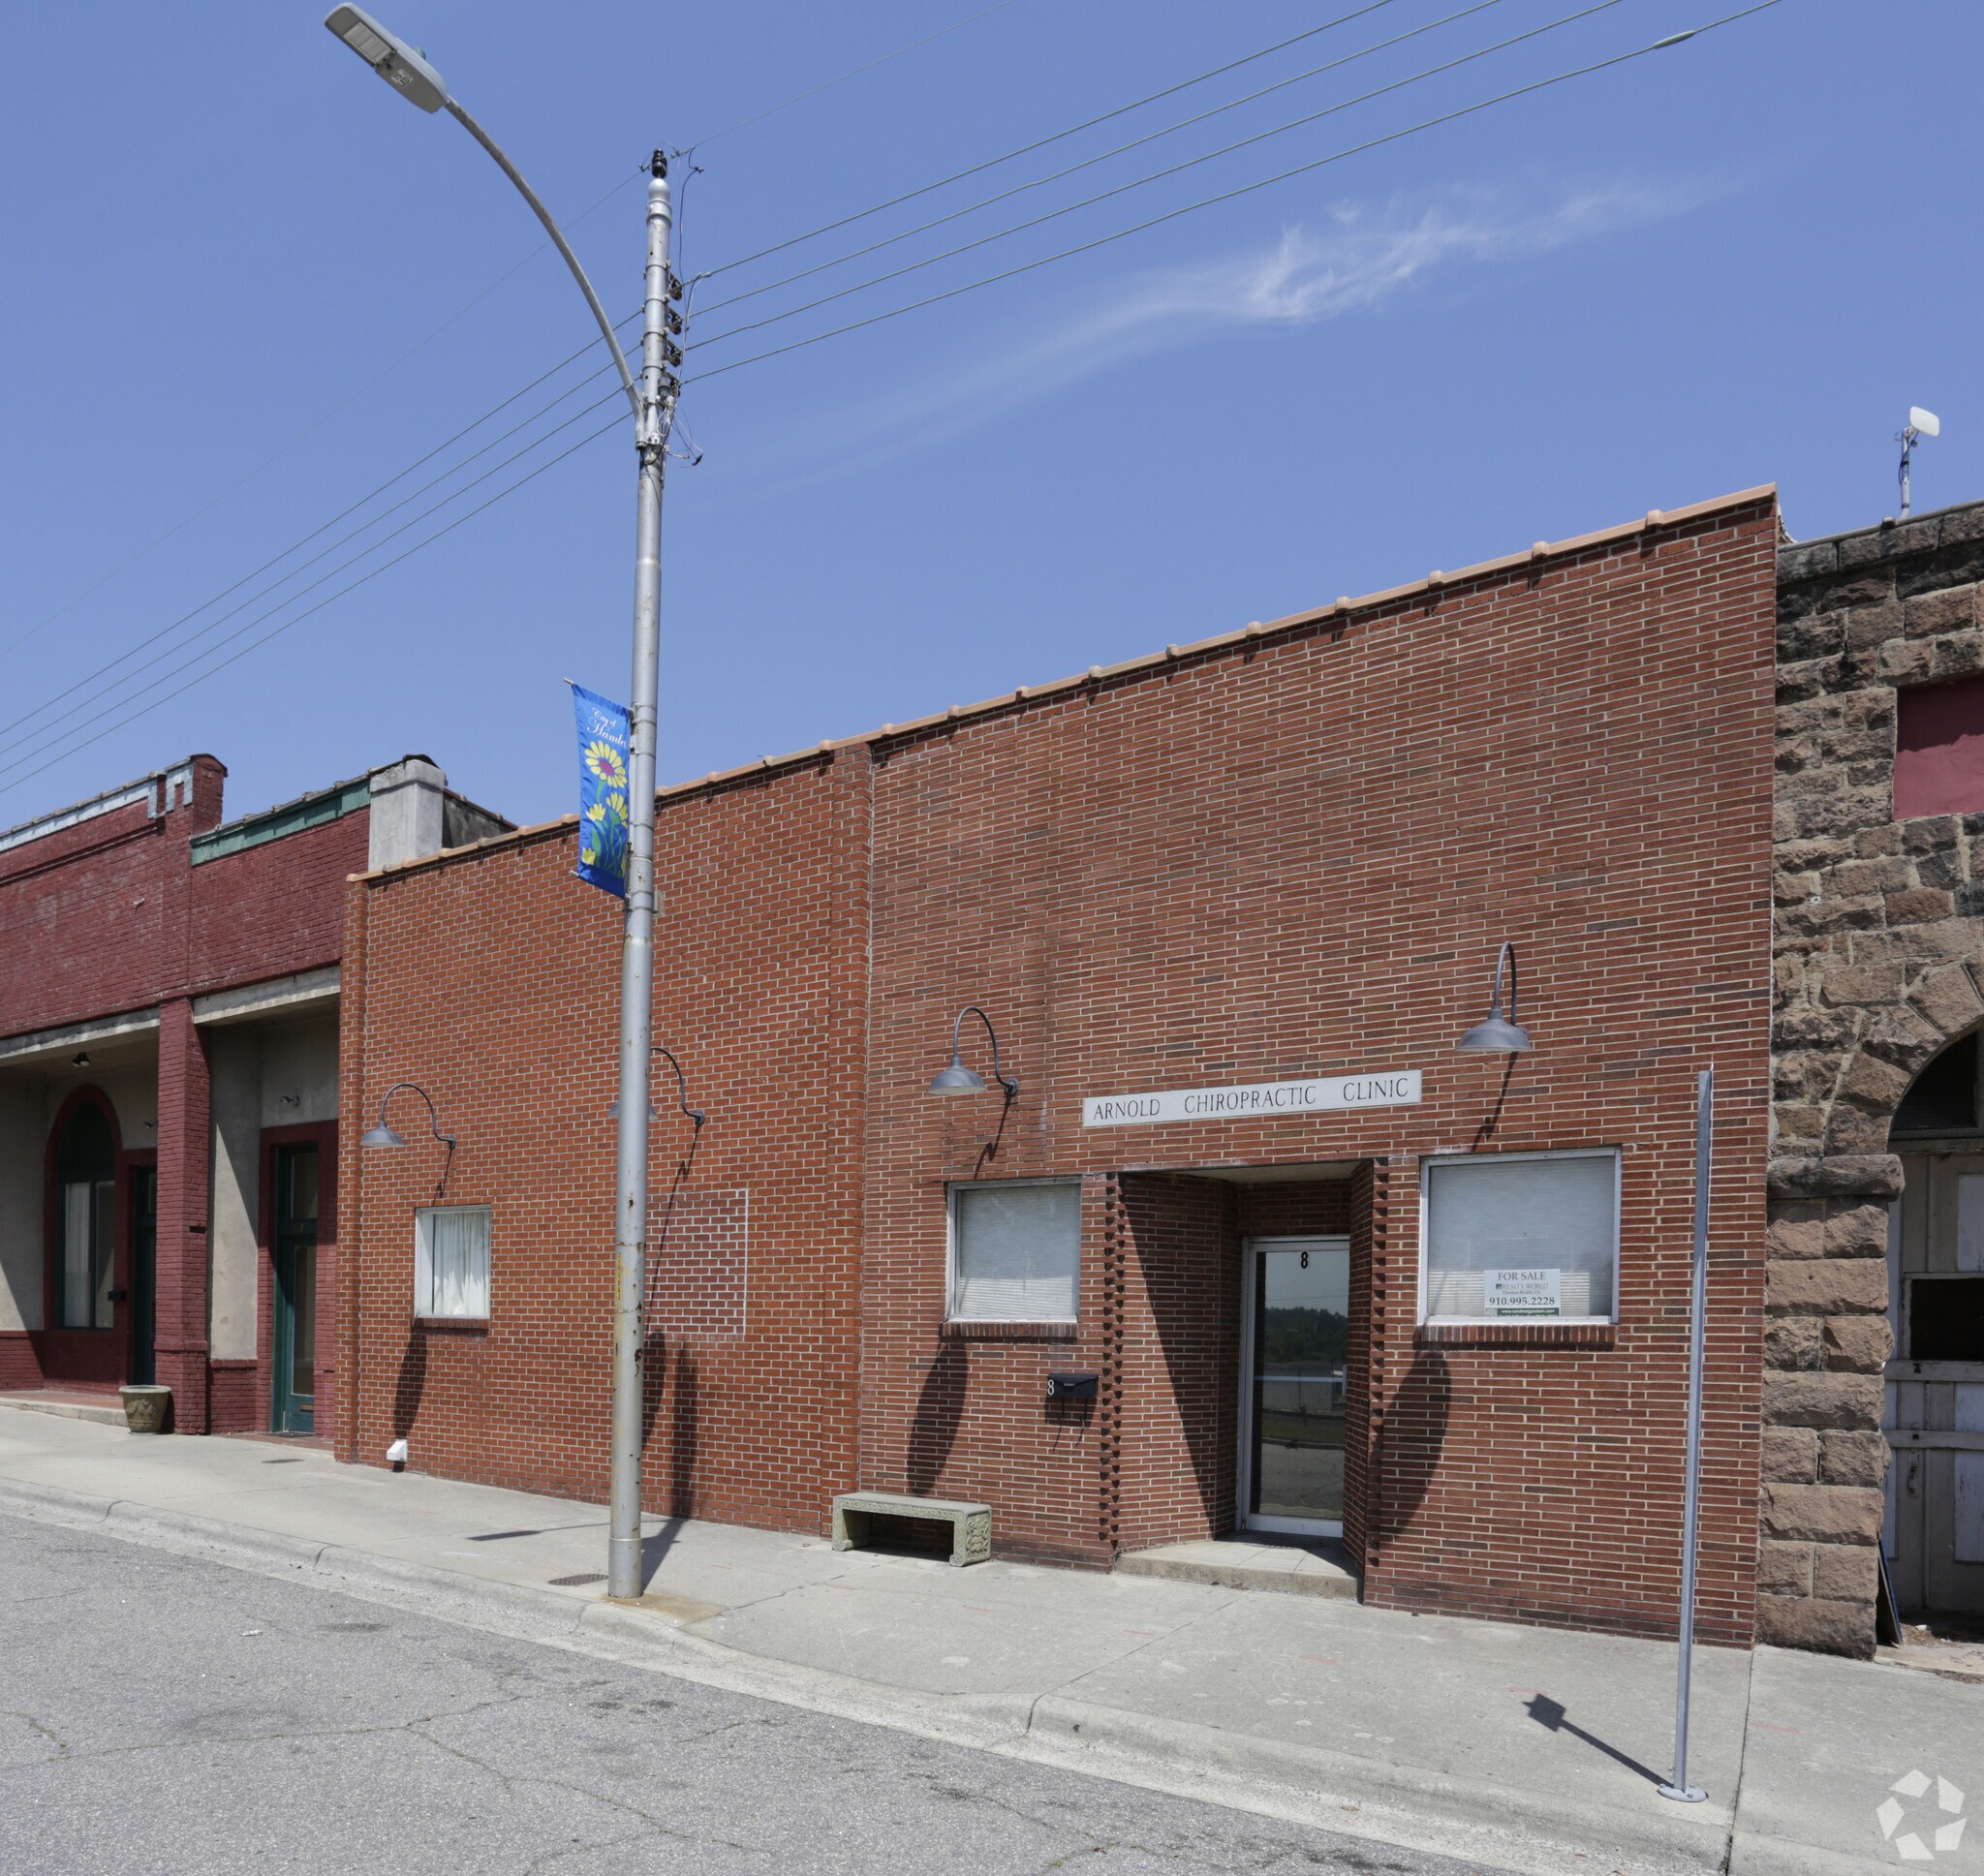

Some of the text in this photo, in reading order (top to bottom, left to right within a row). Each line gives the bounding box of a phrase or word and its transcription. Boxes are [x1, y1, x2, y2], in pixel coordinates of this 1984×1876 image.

[592, 707, 617, 728] City of
[1094, 1078, 1410, 1122] ARNOLD CHIROPRACTIC CLINIC
[1301, 1251, 1309, 1269] 8
[1498, 1272, 1546, 1280] FOR SALE
[1489, 1297, 1556, 1306] 910.995.2228
[1047, 1379, 1055, 1396] 8
